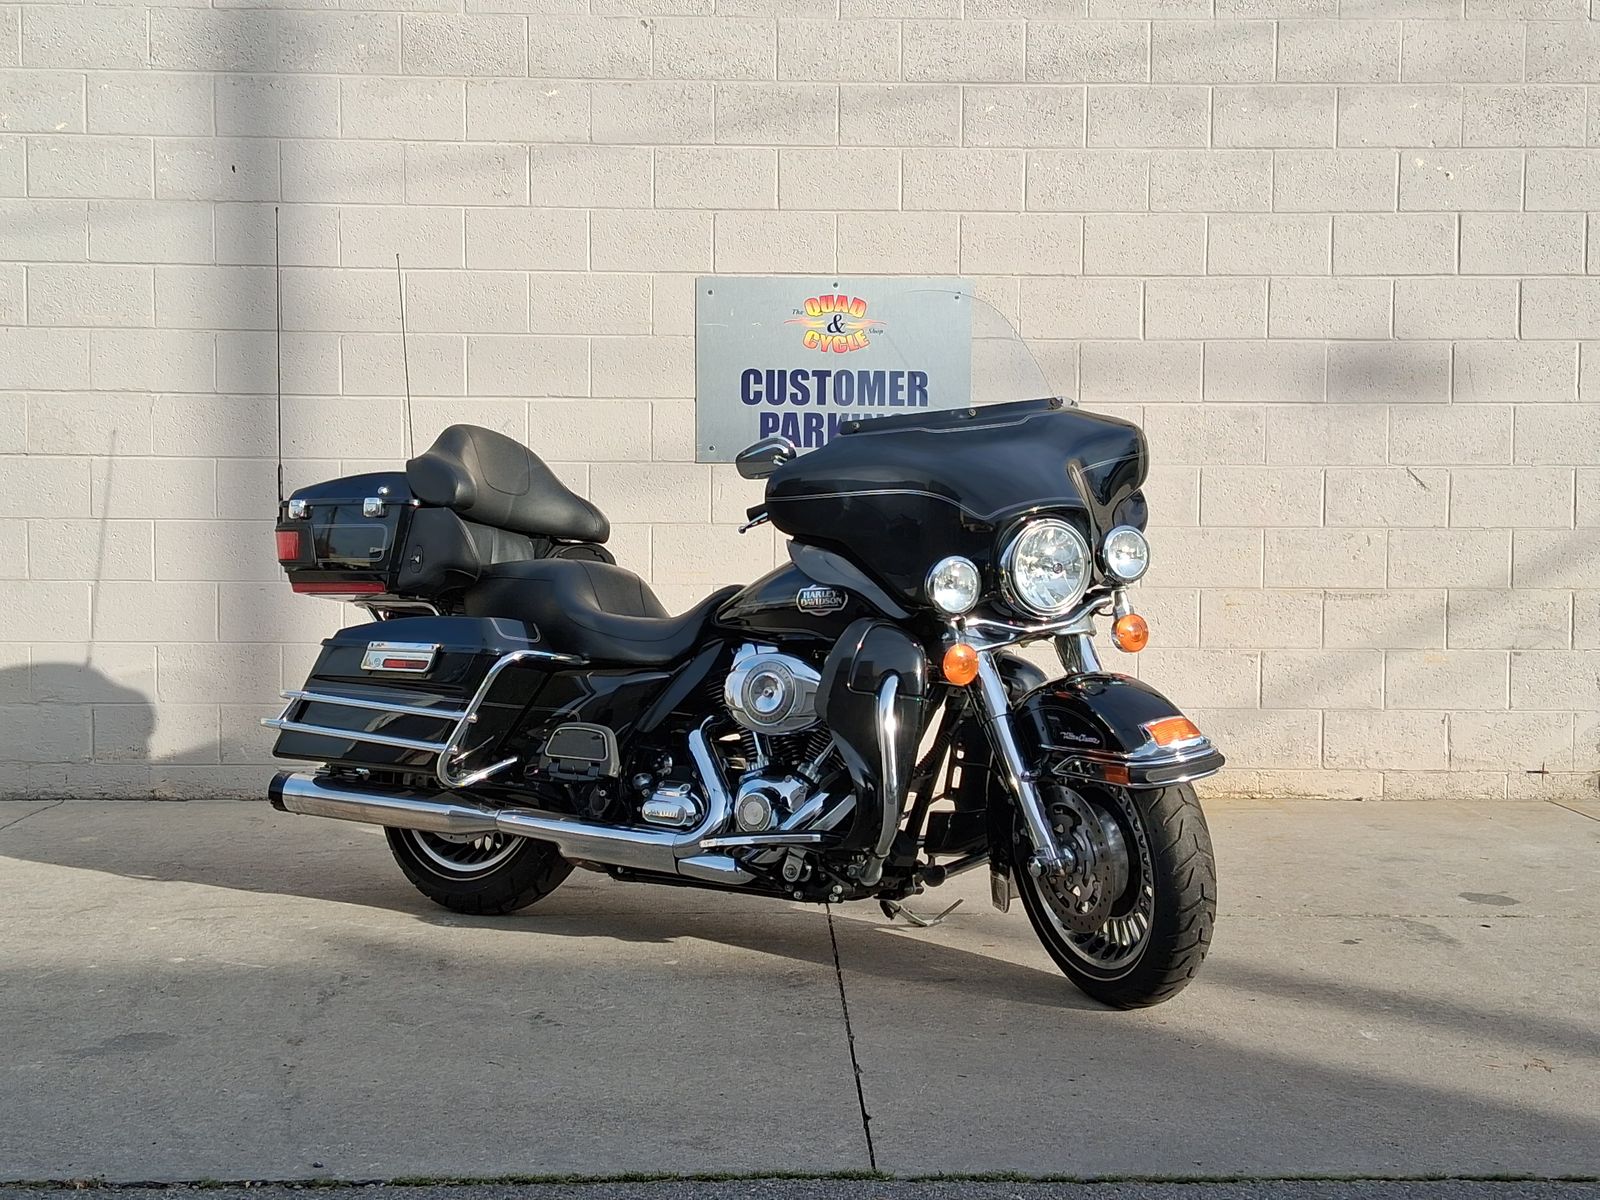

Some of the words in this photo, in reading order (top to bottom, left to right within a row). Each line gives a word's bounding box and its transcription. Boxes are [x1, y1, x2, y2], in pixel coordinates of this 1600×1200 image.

[804, 295, 867, 318] QUAD
[827, 314, 846, 334] &
[803, 330, 870, 353] CYCLE
[741, 368, 928, 407] CUSTOMER
[760, 412, 903, 448] PARK
